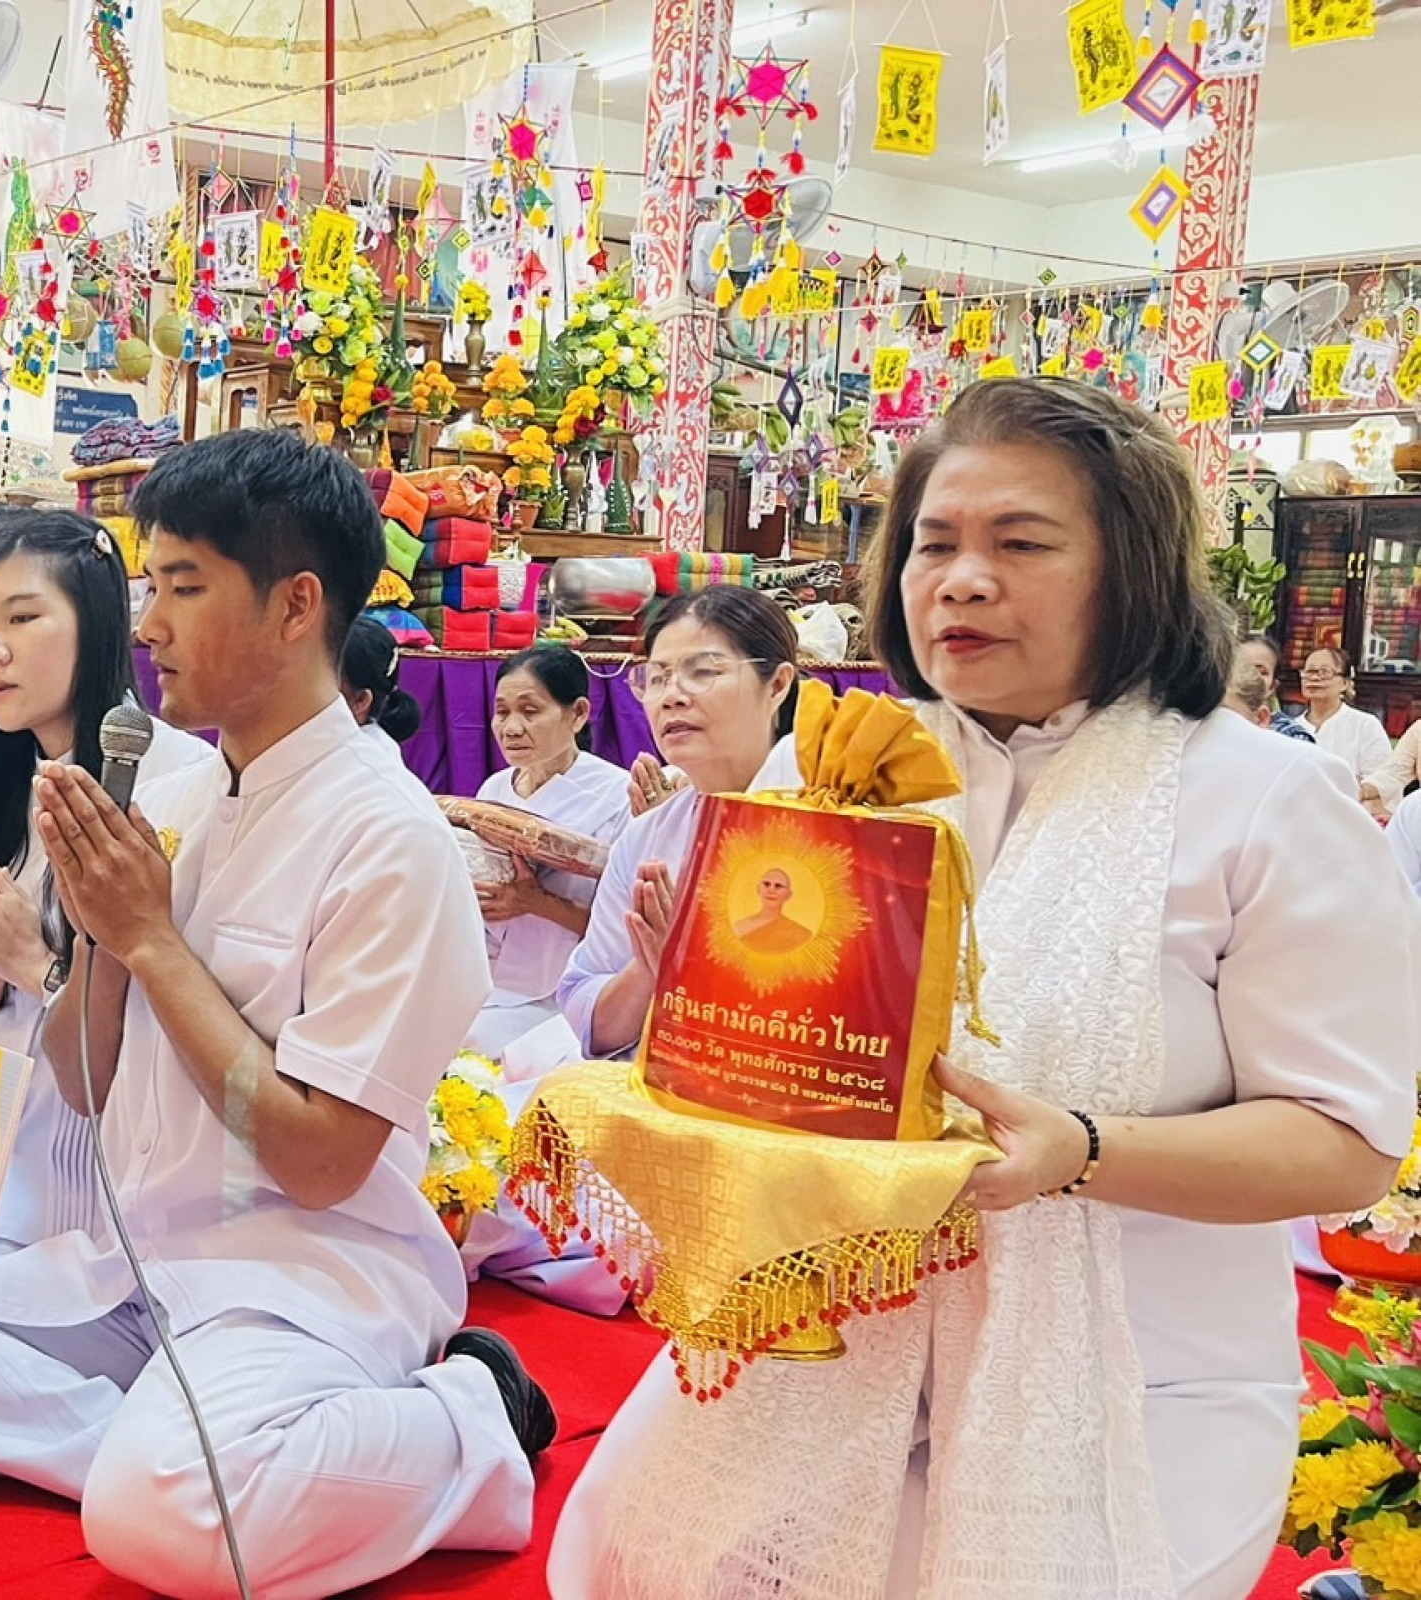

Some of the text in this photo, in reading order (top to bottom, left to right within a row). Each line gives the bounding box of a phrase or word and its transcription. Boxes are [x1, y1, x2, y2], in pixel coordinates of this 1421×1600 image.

[706, 1039, 725, 1059] วัด
[729, 1049, 820, 1080] พุทธศักราช
[825, 1067, 886, 1092] ๒๕๖๘
[790, 1082, 800, 1097] ปี
